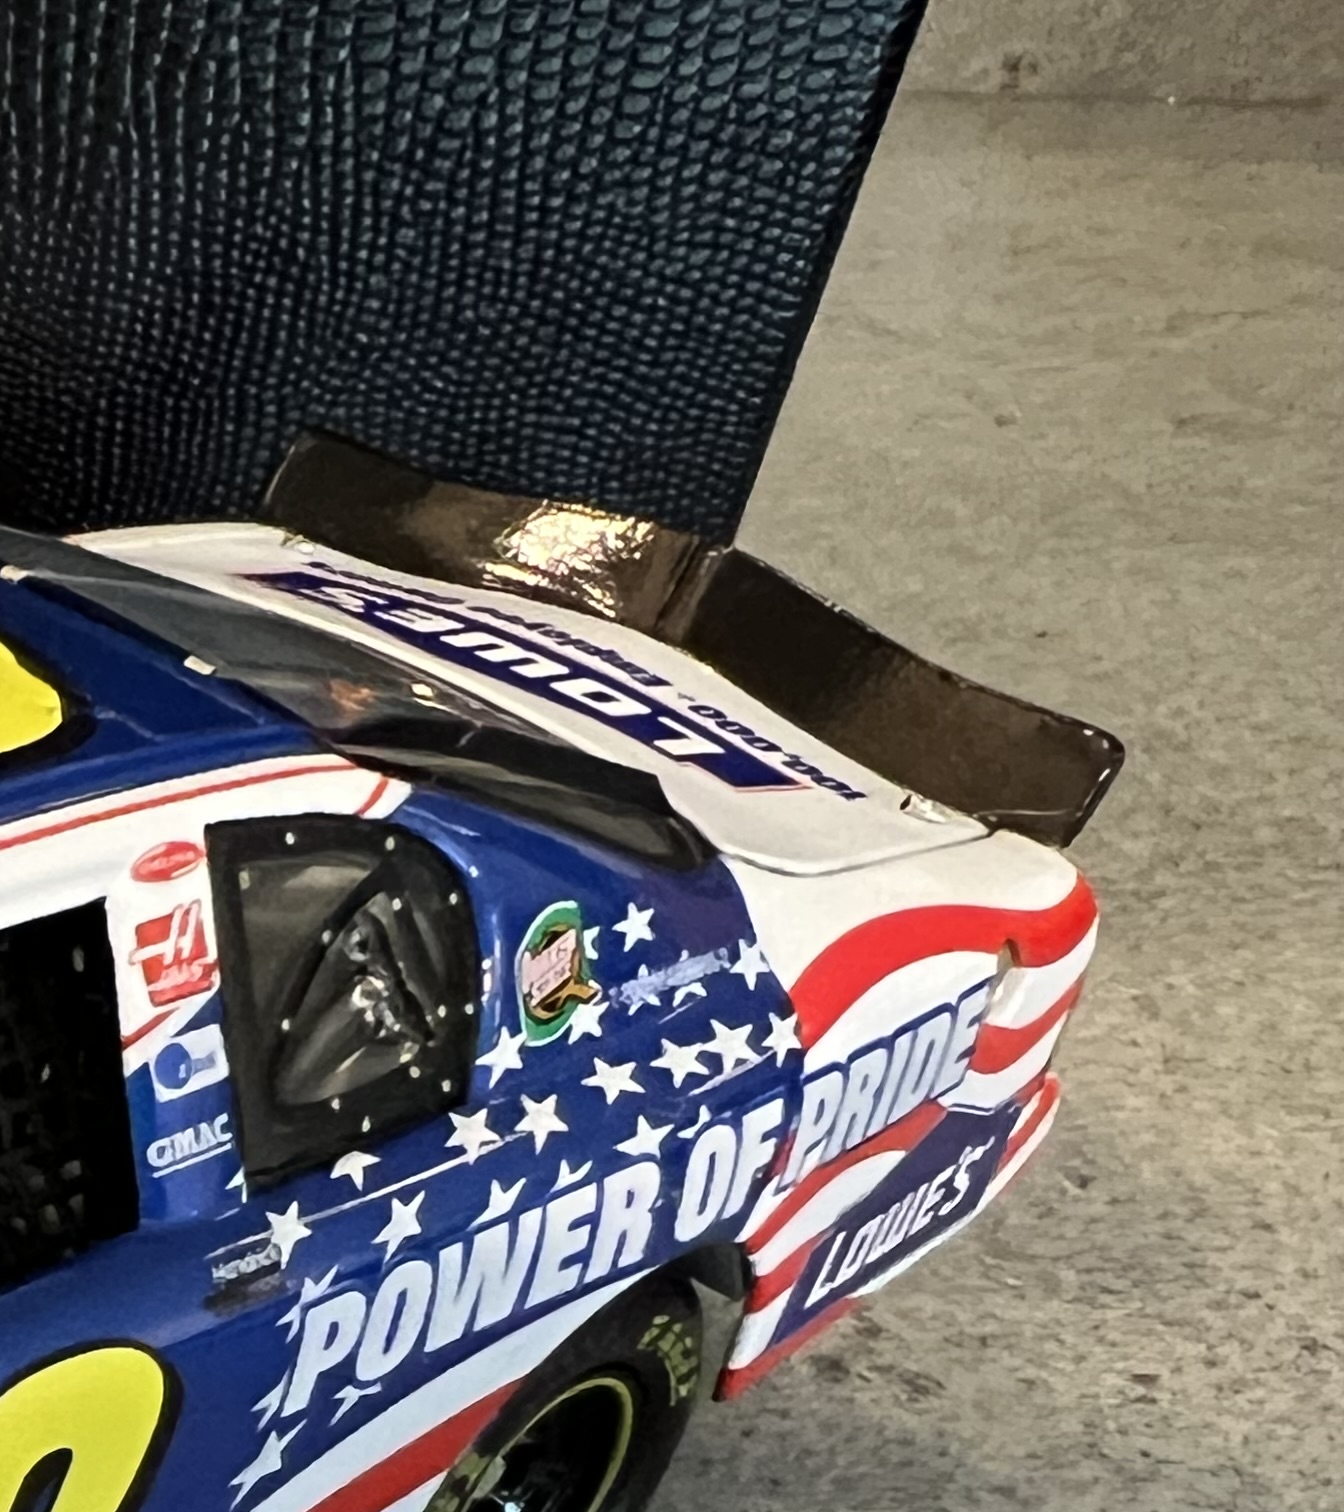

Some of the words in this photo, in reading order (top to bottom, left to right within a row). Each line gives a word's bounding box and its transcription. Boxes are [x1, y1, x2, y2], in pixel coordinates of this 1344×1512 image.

[282, 1160, 664, 1417] POWER
[674, 1098, 784, 1241] OF
[776, 982, 992, 1197] PRIDE
